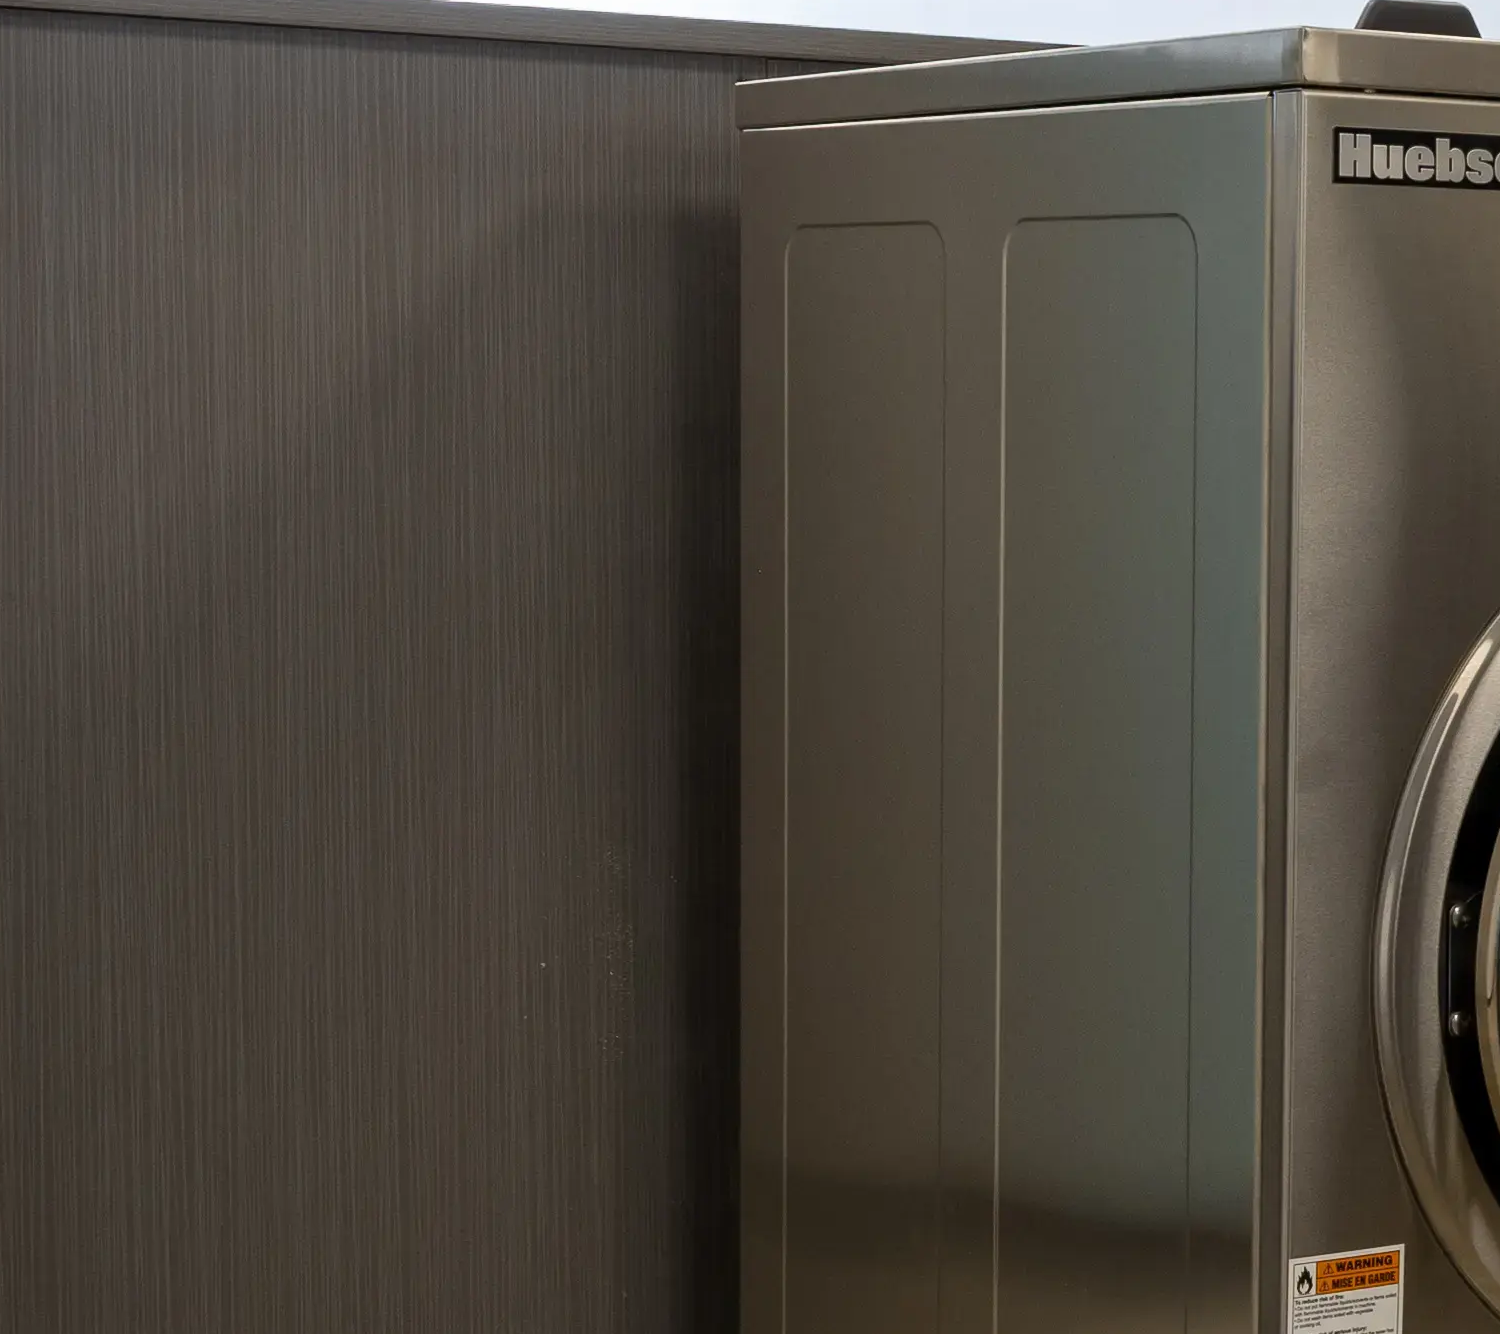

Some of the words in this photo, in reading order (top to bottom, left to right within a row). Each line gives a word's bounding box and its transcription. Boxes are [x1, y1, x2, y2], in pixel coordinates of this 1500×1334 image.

[1336, 1255, 1393, 1272] WARNING
[1332, 1277, 1353, 1289] MISE
[1355, 1275, 1366, 1286] EN
[1368, 1271, 1396, 1284] GARDE
